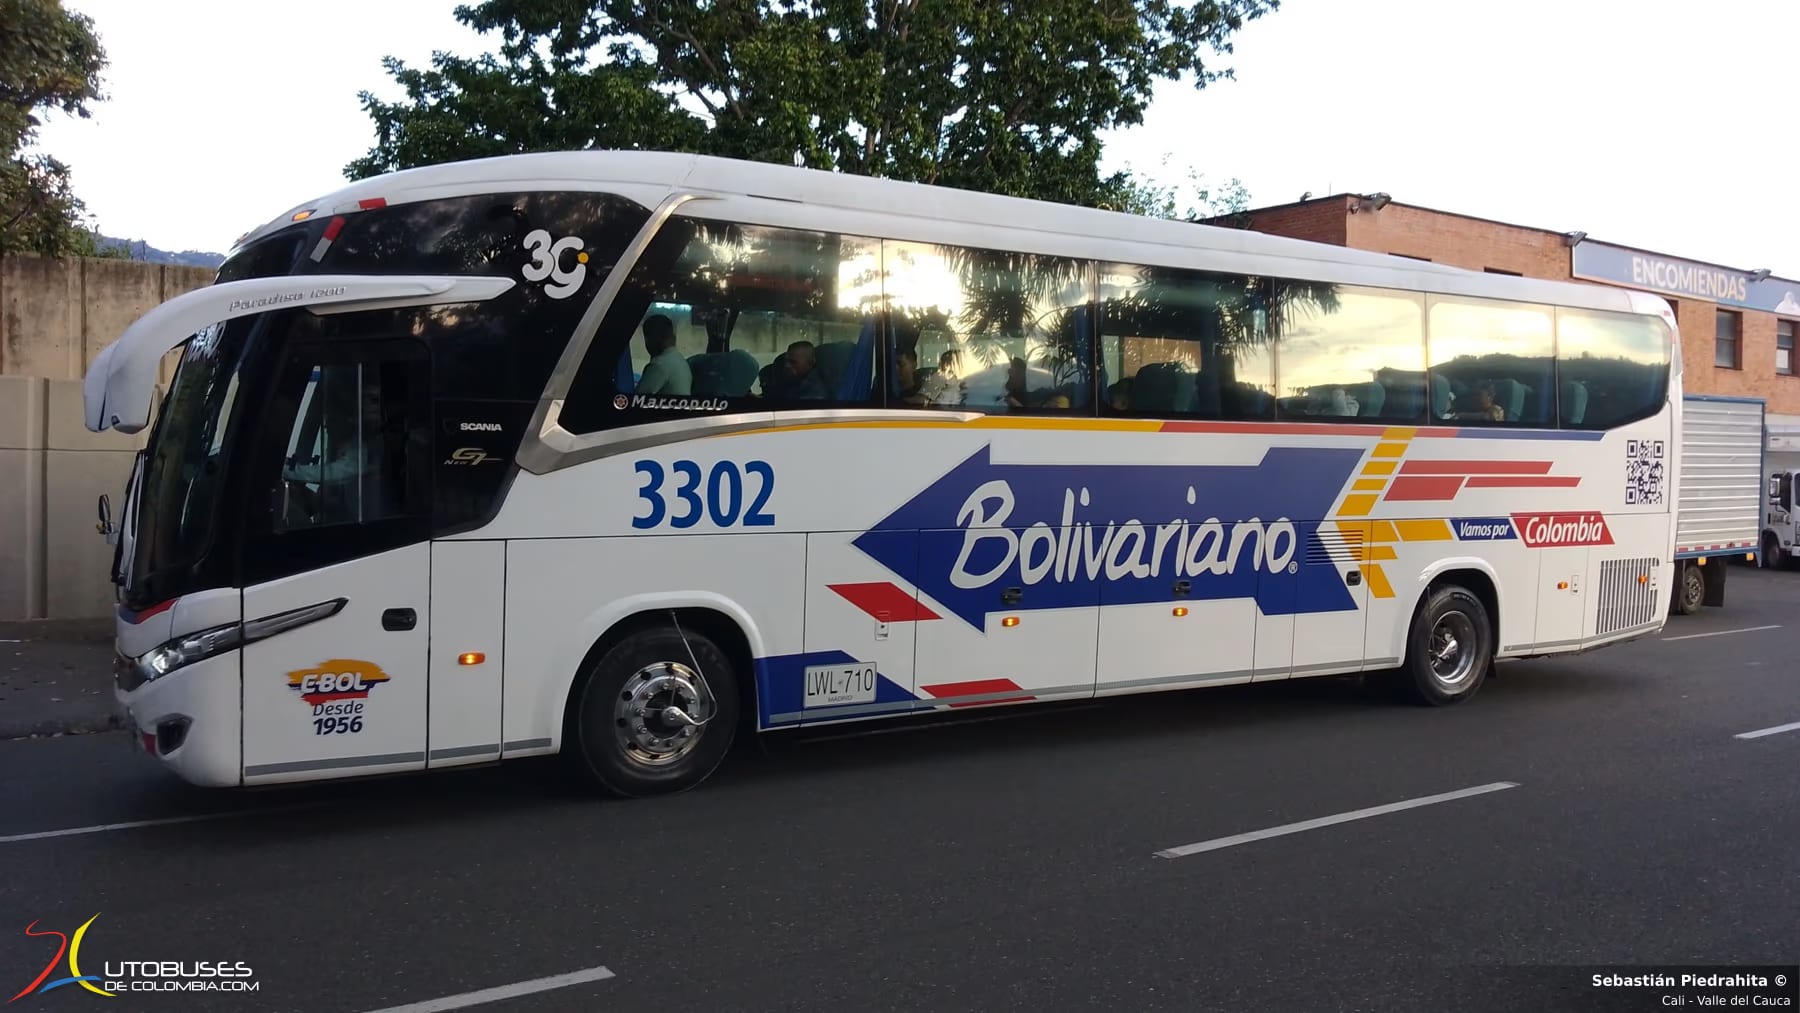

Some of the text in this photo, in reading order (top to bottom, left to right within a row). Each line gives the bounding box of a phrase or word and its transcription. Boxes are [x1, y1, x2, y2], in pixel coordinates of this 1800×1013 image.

[1632, 255, 1747, 301] ENCOMIENDAS
[632, 395, 729, 411] Marcopolo
[460, 422, 502, 431] SCANIA
[632, 459, 776, 530] 3302
[1460, 522, 1509, 539] Vamos por
[1525, 515, 1603, 544] Colombia
[312, 700, 364, 717] Desde
[313, 715, 364, 736] 1956
